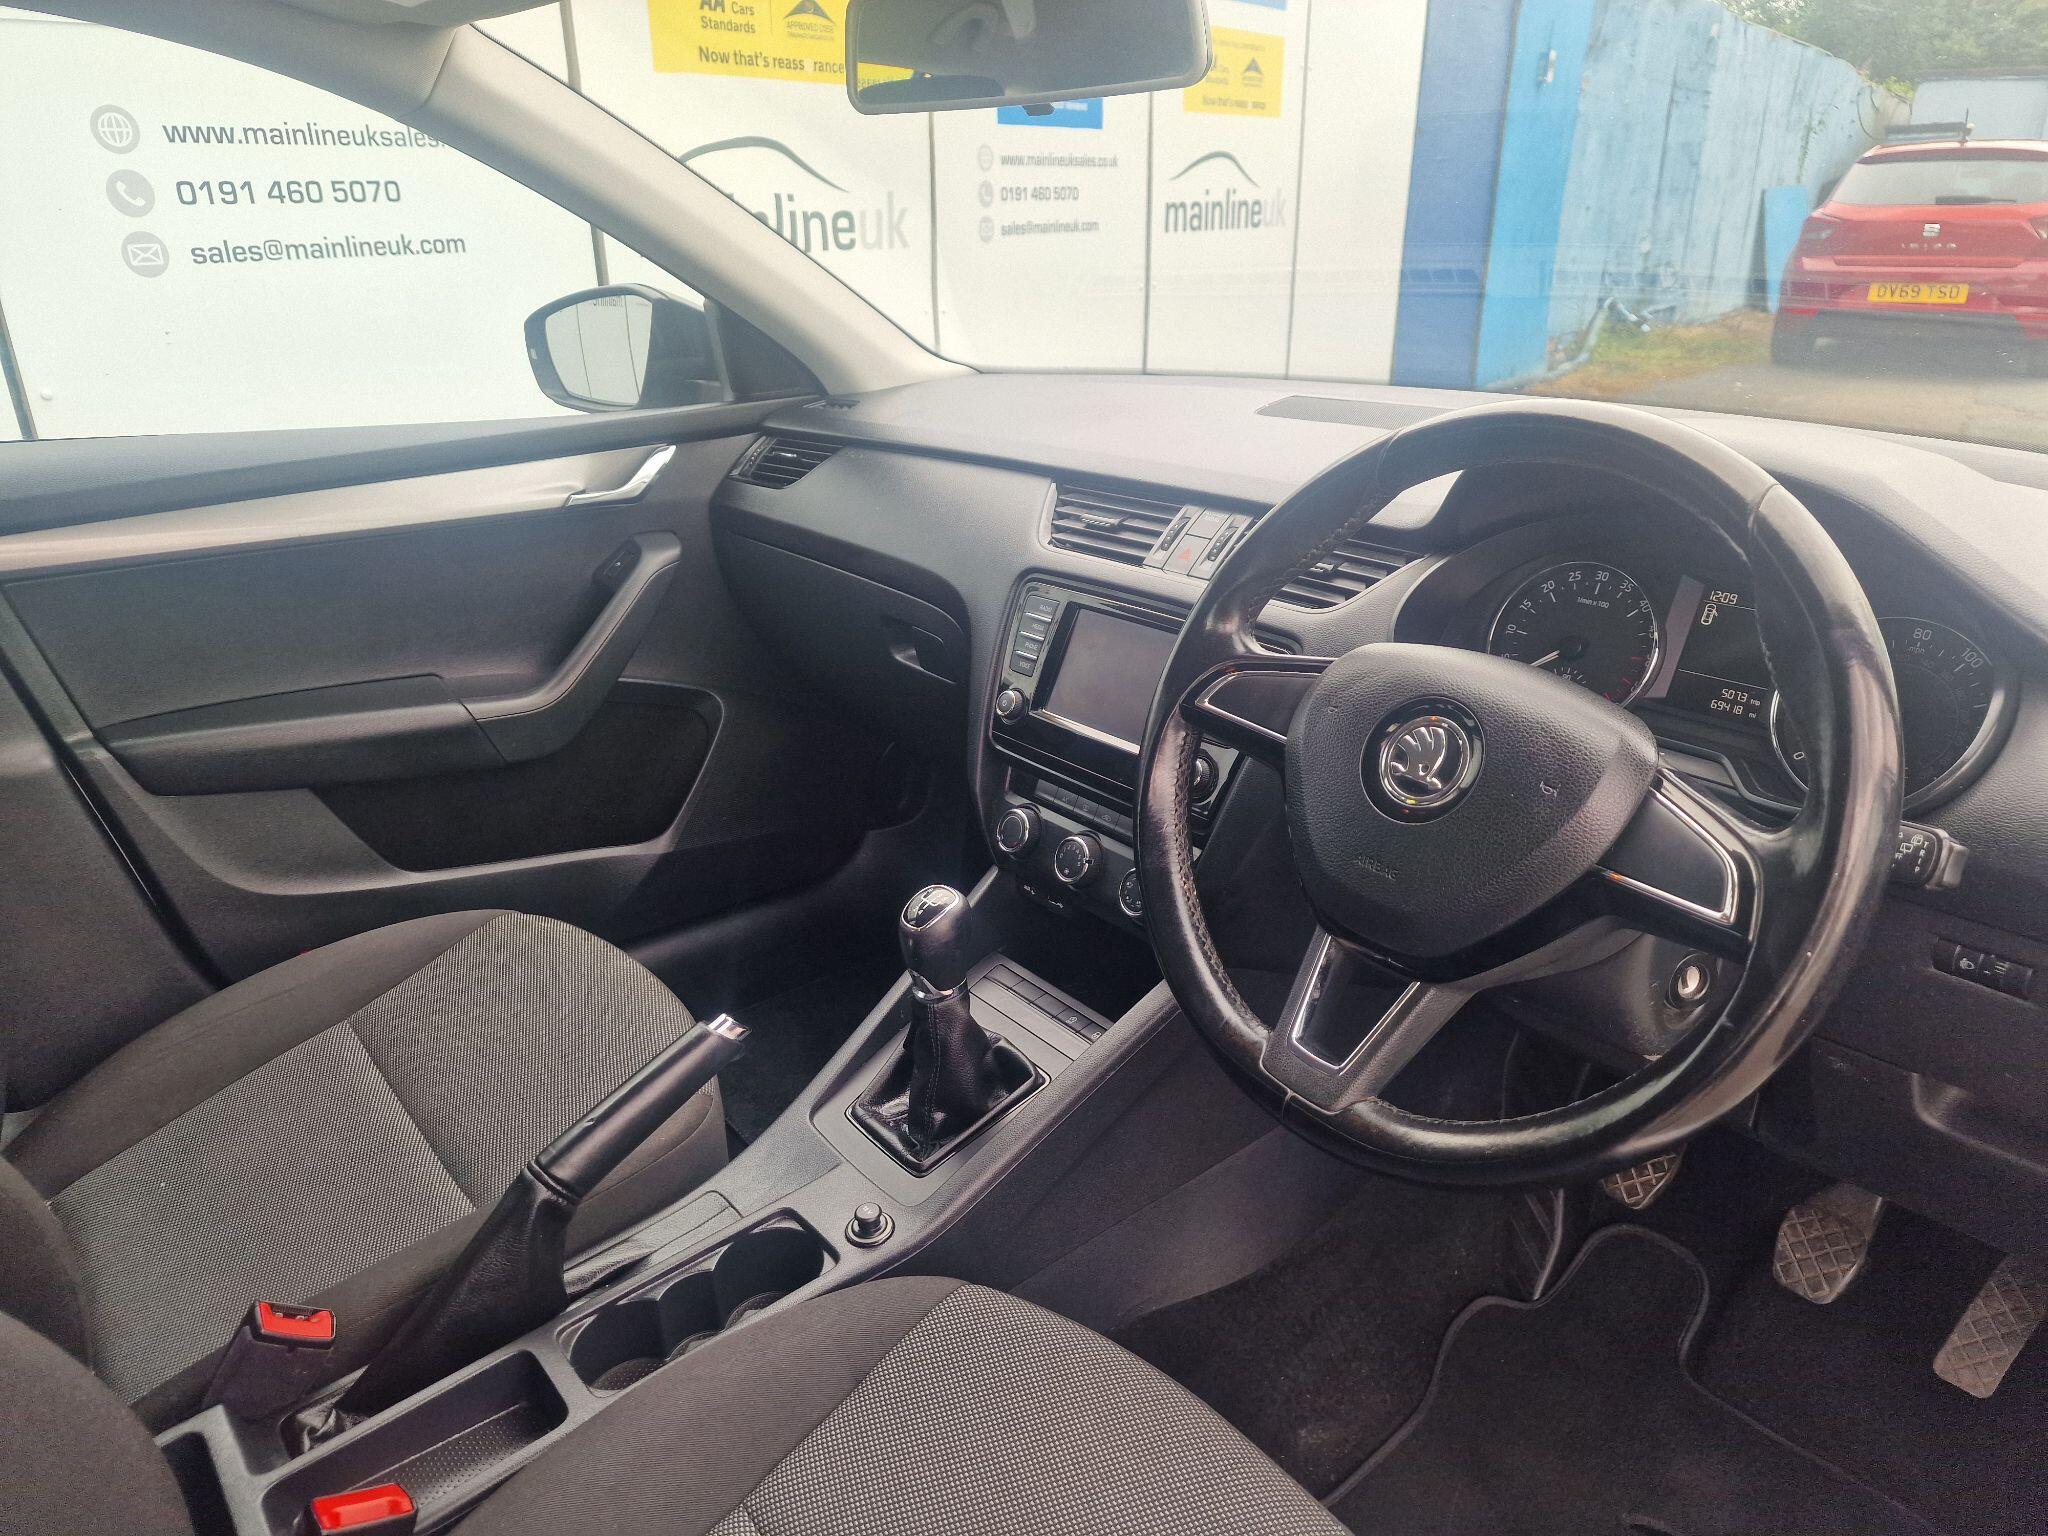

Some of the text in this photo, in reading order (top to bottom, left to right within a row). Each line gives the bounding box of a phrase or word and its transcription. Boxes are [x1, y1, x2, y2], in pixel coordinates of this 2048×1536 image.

[731, 3, 755, 16] Cars
[700, 16, 756, 34] Standards
[698, 46, 730, 64] Now
[733, 49, 769, 68] that's
[162, 121, 447, 148] www.mainlineuksales.
[176, 179, 402, 206] 0191 460 5070
[1001, 186, 1079, 201] 0191 460 5070
[1164, 187, 1286, 233] mainlineuk
[752, 190, 910, 254] lineuk
[191, 233, 467, 265] sales@mainlineuk.com
[1568, 571, 1582, 582] 25
[1595, 571, 1610, 582] 30
[1540, 580, 1555, 594] 20
[1619, 580, 1635, 593] 35
[1519, 598, 1532, 610] 15
[1639, 599, 1650, 614] 40
[1505, 624, 1517, 635] 10
[1913, 628, 1932, 641] 80
[1961, 647, 1983, 668] 100
[1711, 699, 1744, 715] 69418
[1793, 751, 1805, 760] 0
[1914, 841, 1929, 873] TRIP
